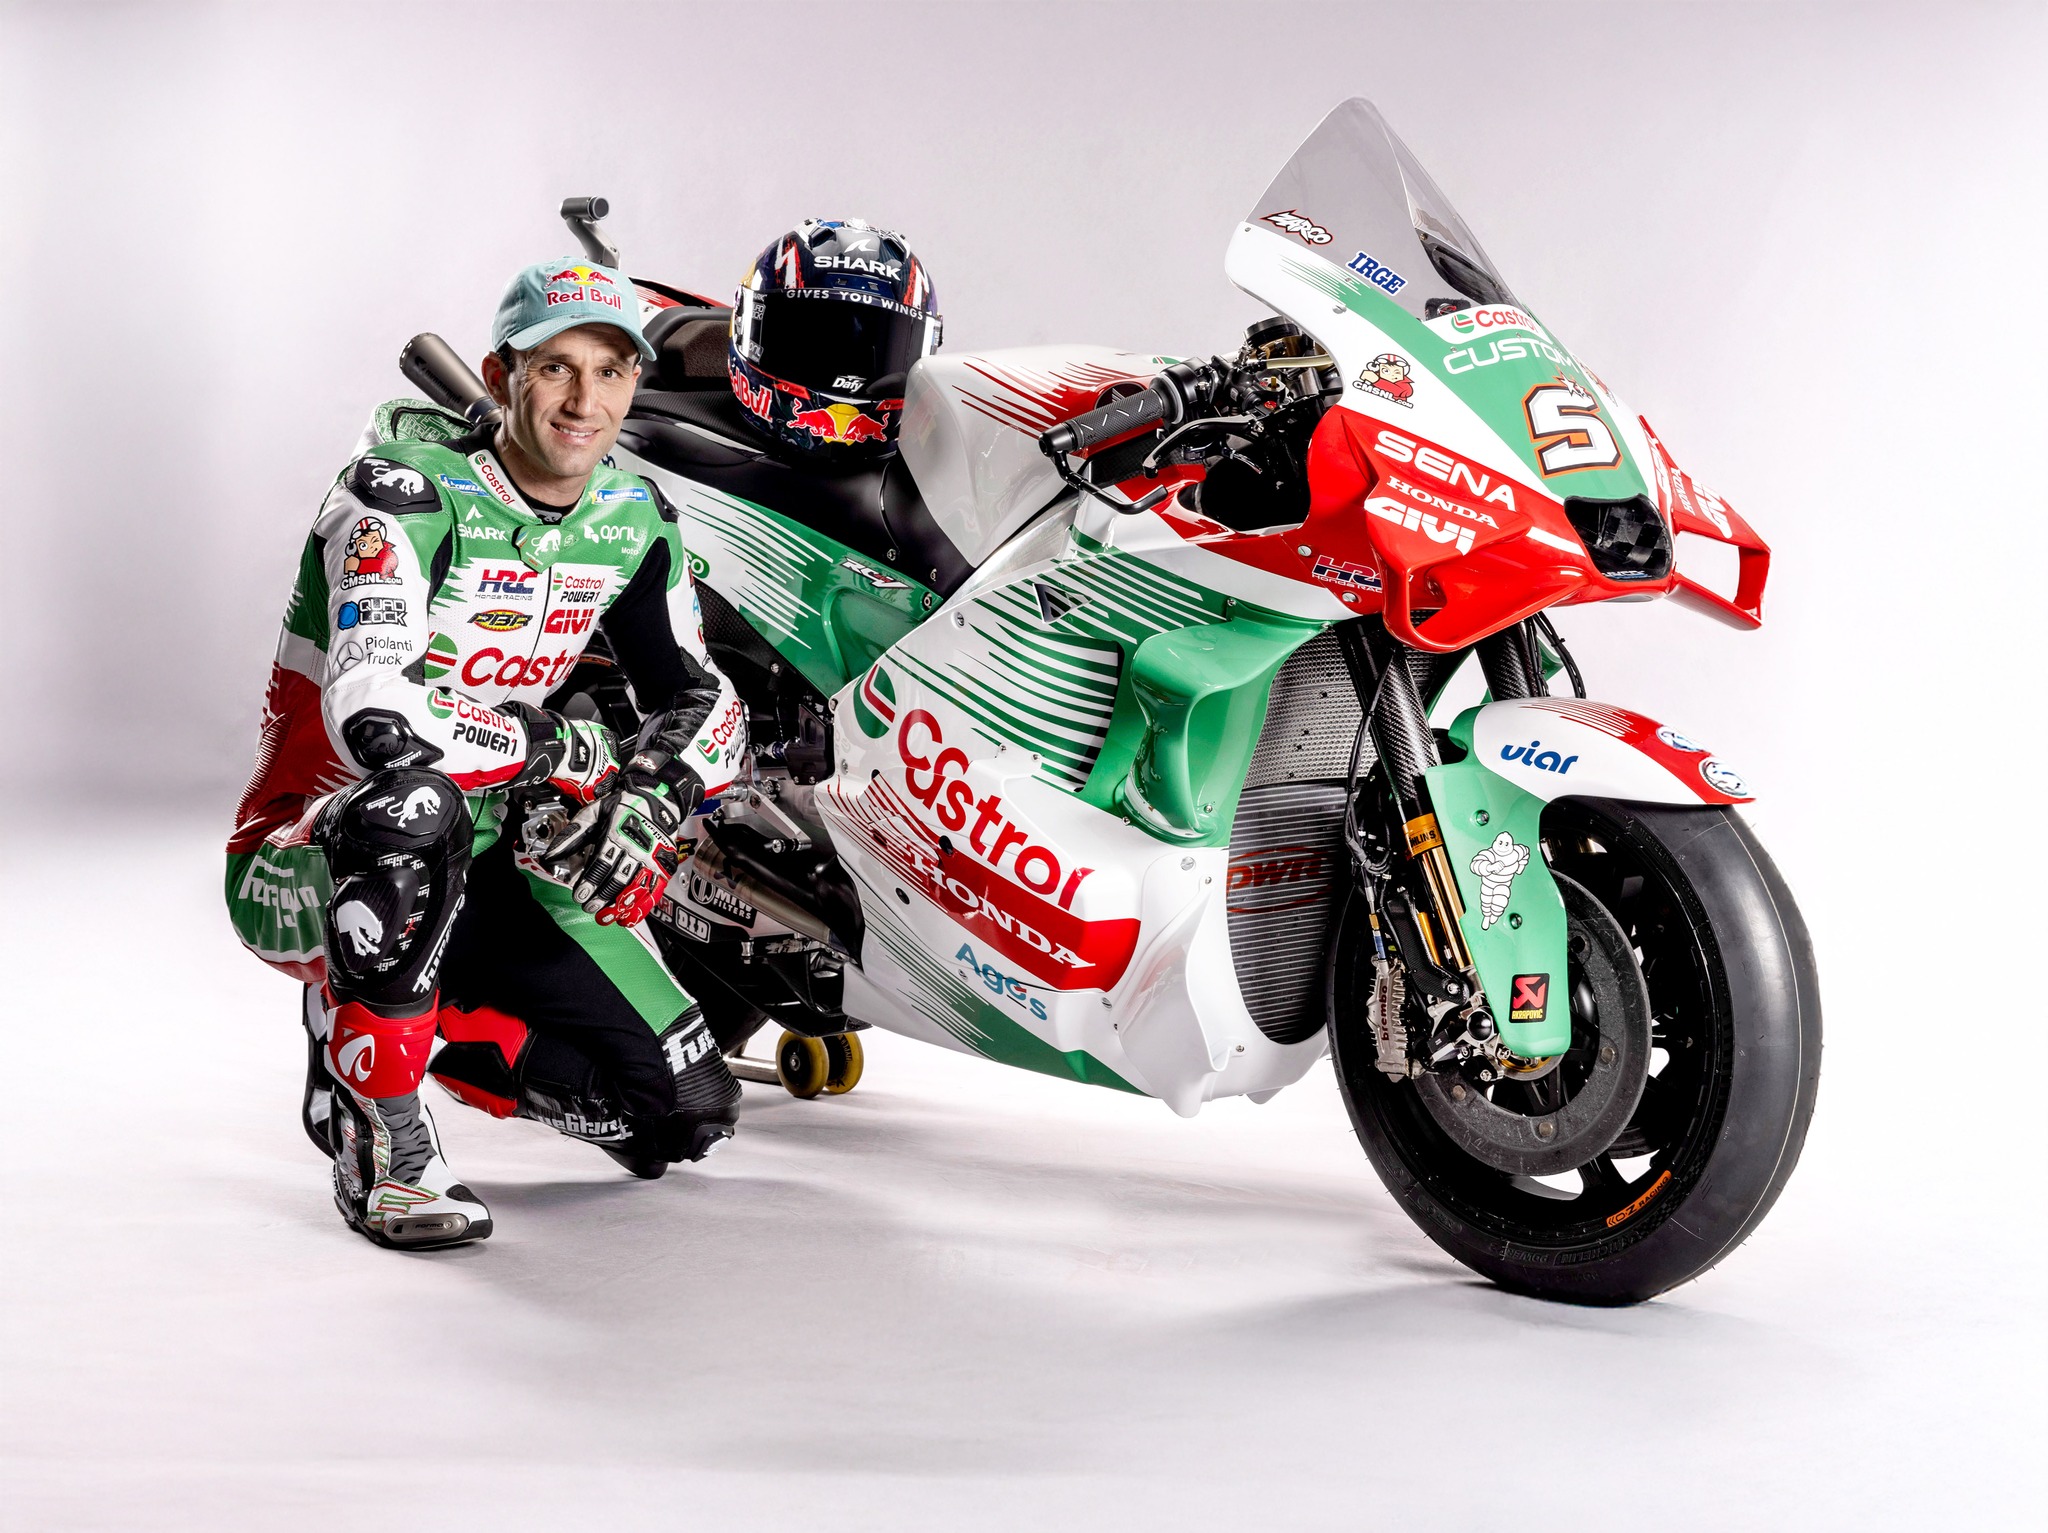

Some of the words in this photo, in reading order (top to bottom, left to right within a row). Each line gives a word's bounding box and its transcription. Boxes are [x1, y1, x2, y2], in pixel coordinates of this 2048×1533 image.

[1260, 209, 1333, 245] ZARCO
[813, 255, 902, 281] SHARK
[1347, 252, 1406, 295] IRGE
[547, 286, 585, 307] Red
[590, 288, 621, 311] Bull
[786, 289, 830, 300] GIVES
[839, 291, 873, 305] YOU
[880, 298, 924, 321] WINGS
[740, 372, 773, 423] Bull
[832, 377, 865, 392] Dafy
[1522, 383, 1622, 480] 5
[481, 464, 516, 505] Castrol
[1374, 429, 1516, 512] SENA
[1386, 475, 1499, 530] HONDA
[457, 523, 509, 542] SHARK
[1364, 496, 1476, 557] GIVI
[478, 569, 538, 595] HRC
[560, 591, 601, 603] POWER1
[565, 575, 605, 590] Castrol
[360, 598, 406, 612] QUAD
[360, 611, 407, 627] LOCK
[467, 612, 534, 627] PBR
[544, 608, 595, 635] GIVI
[365, 636, 413, 652] Piolanti
[367, 652, 403, 665] Truck
[453, 722, 518, 757] POWER1
[1500, 740, 1578, 775] viar
[899, 708, 1095, 911] Castrol
[712, 898, 752, 920] FILTERS
[911, 851, 1096, 969] HONDA
[1380, 984, 1390, 1042] brembo
[1638, 1176, 1669, 1208] RACING
